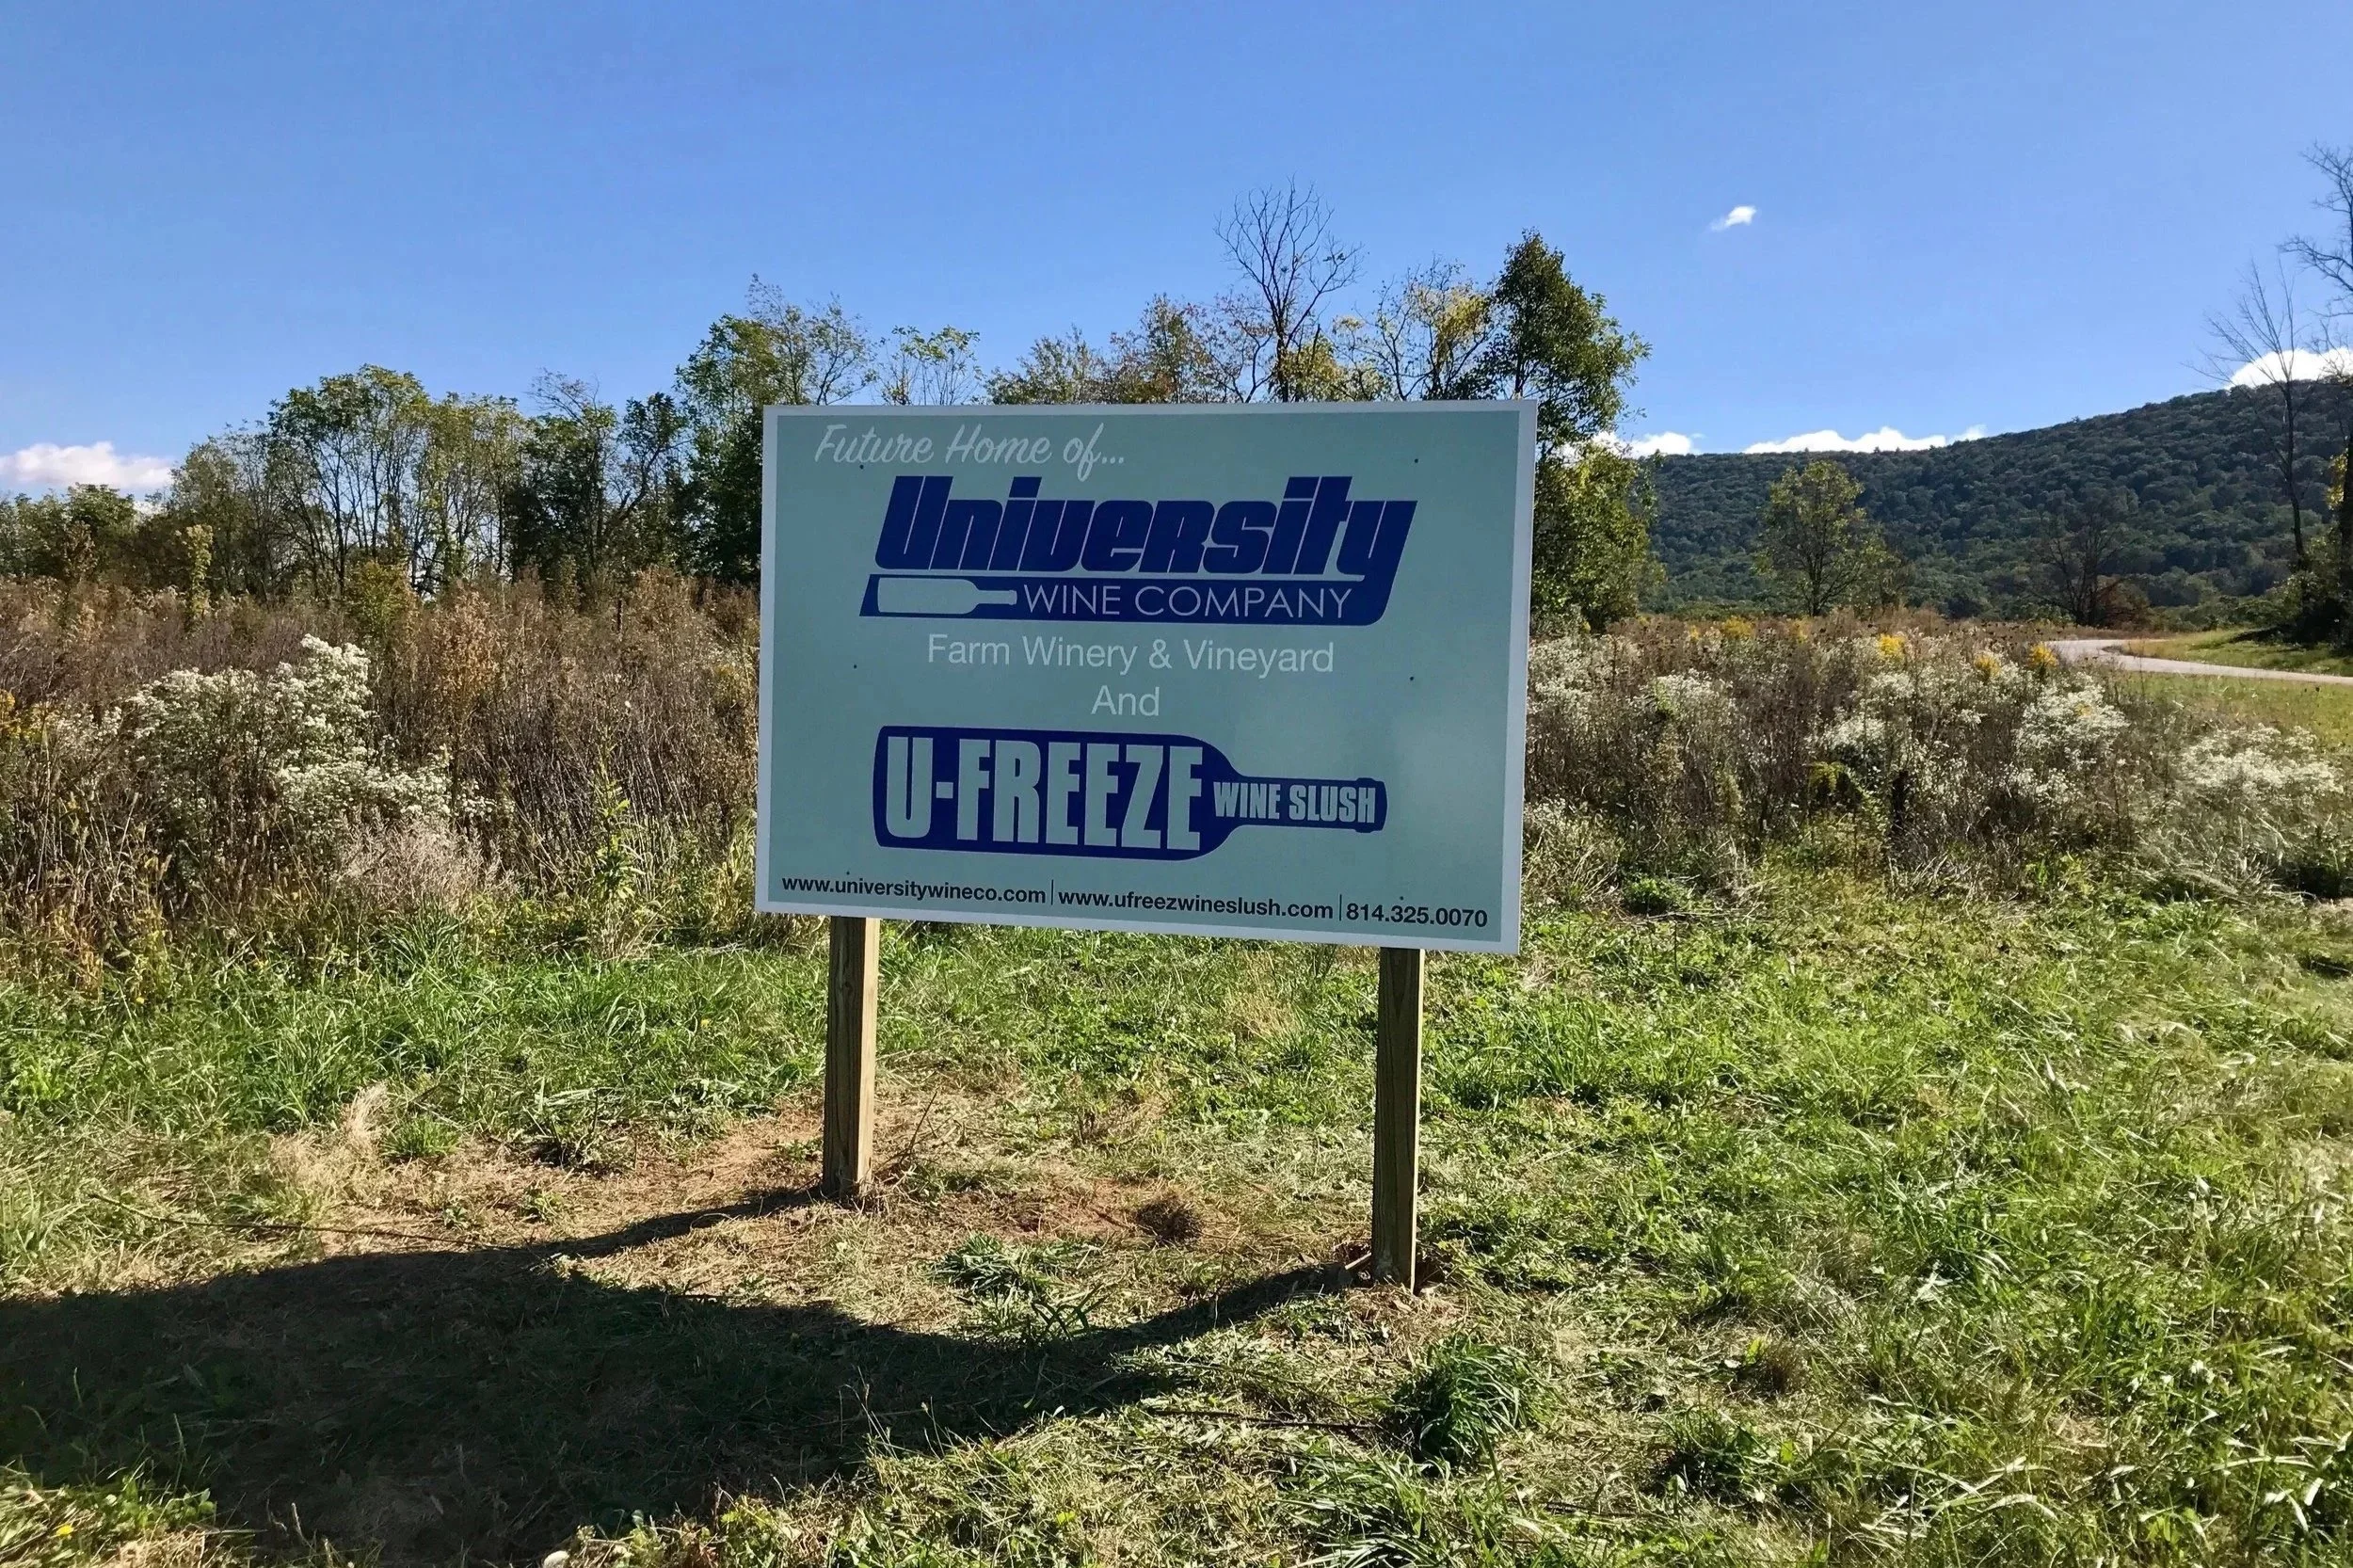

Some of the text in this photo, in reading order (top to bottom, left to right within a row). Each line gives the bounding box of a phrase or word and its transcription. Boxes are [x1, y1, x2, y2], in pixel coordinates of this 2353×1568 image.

[815, 422, 1126, 481] Future Home of...
[1023, 584, 1353, 619] WINE COMPANY
[927, 633, 1335, 680] Farm Winery & Vineyard
[1091, 685, 1160, 717] And
[885, 737, 1203, 851] U-FREEZE
[1212, 780, 1376, 824] WINE SLUSH
[781, 876, 1047, 904] www.universitywineco.com
[1058, 890, 1334, 920] www.ufreezwineslush.com
[1346, 904, 1489, 929] 814.325.0070
